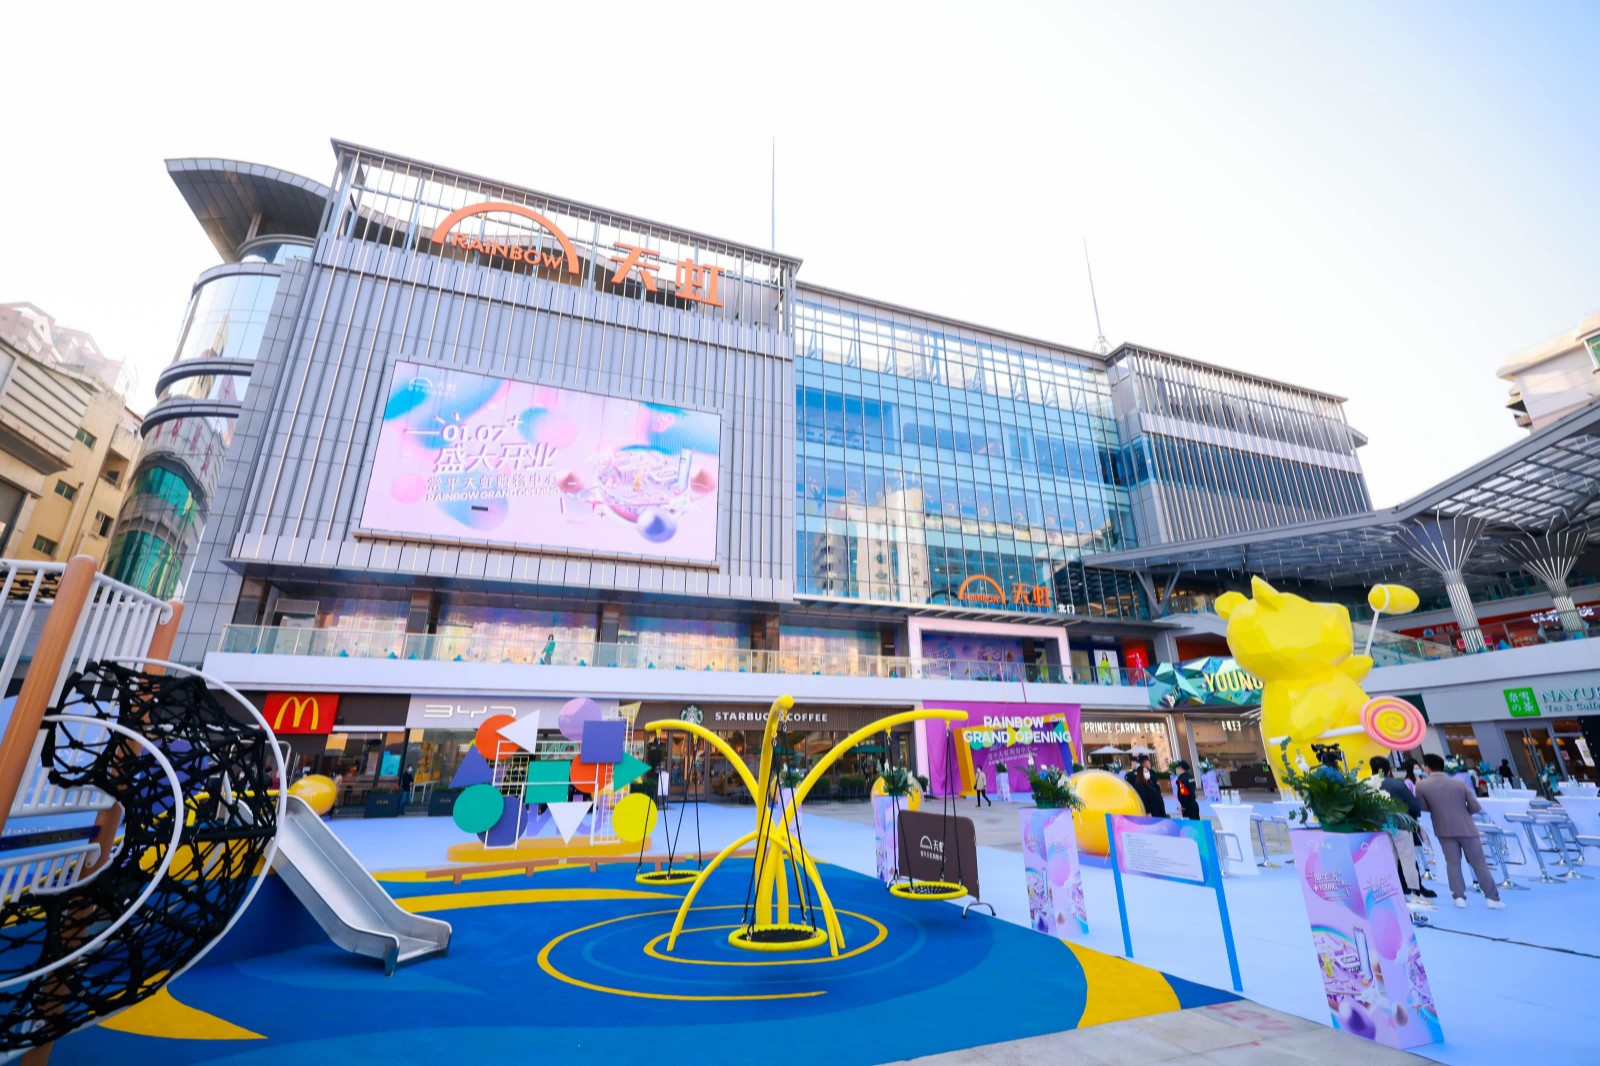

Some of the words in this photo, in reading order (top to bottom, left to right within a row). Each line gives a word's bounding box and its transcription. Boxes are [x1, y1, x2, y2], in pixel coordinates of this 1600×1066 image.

[452, 233, 564, 270] RAINBOW
[610, 241, 725, 308] 天虹
[441, 424, 507, 442] 01.07
[433, 442, 558, 474] 盛大开业
[426, 491, 479, 502] RAINBOW
[1011, 582, 1052, 608] 天虹
[715, 711, 785, 722] STARBUC
[787, 712, 828, 722] COFFEE
[983, 715, 1045, 729] RAINBOW
[1084, 722, 1112, 734] PRINCE
[1115, 722, 1141, 734] CARMA
[963, 730, 1010, 743] GRAND
[1015, 730, 1072, 743] OPENING
